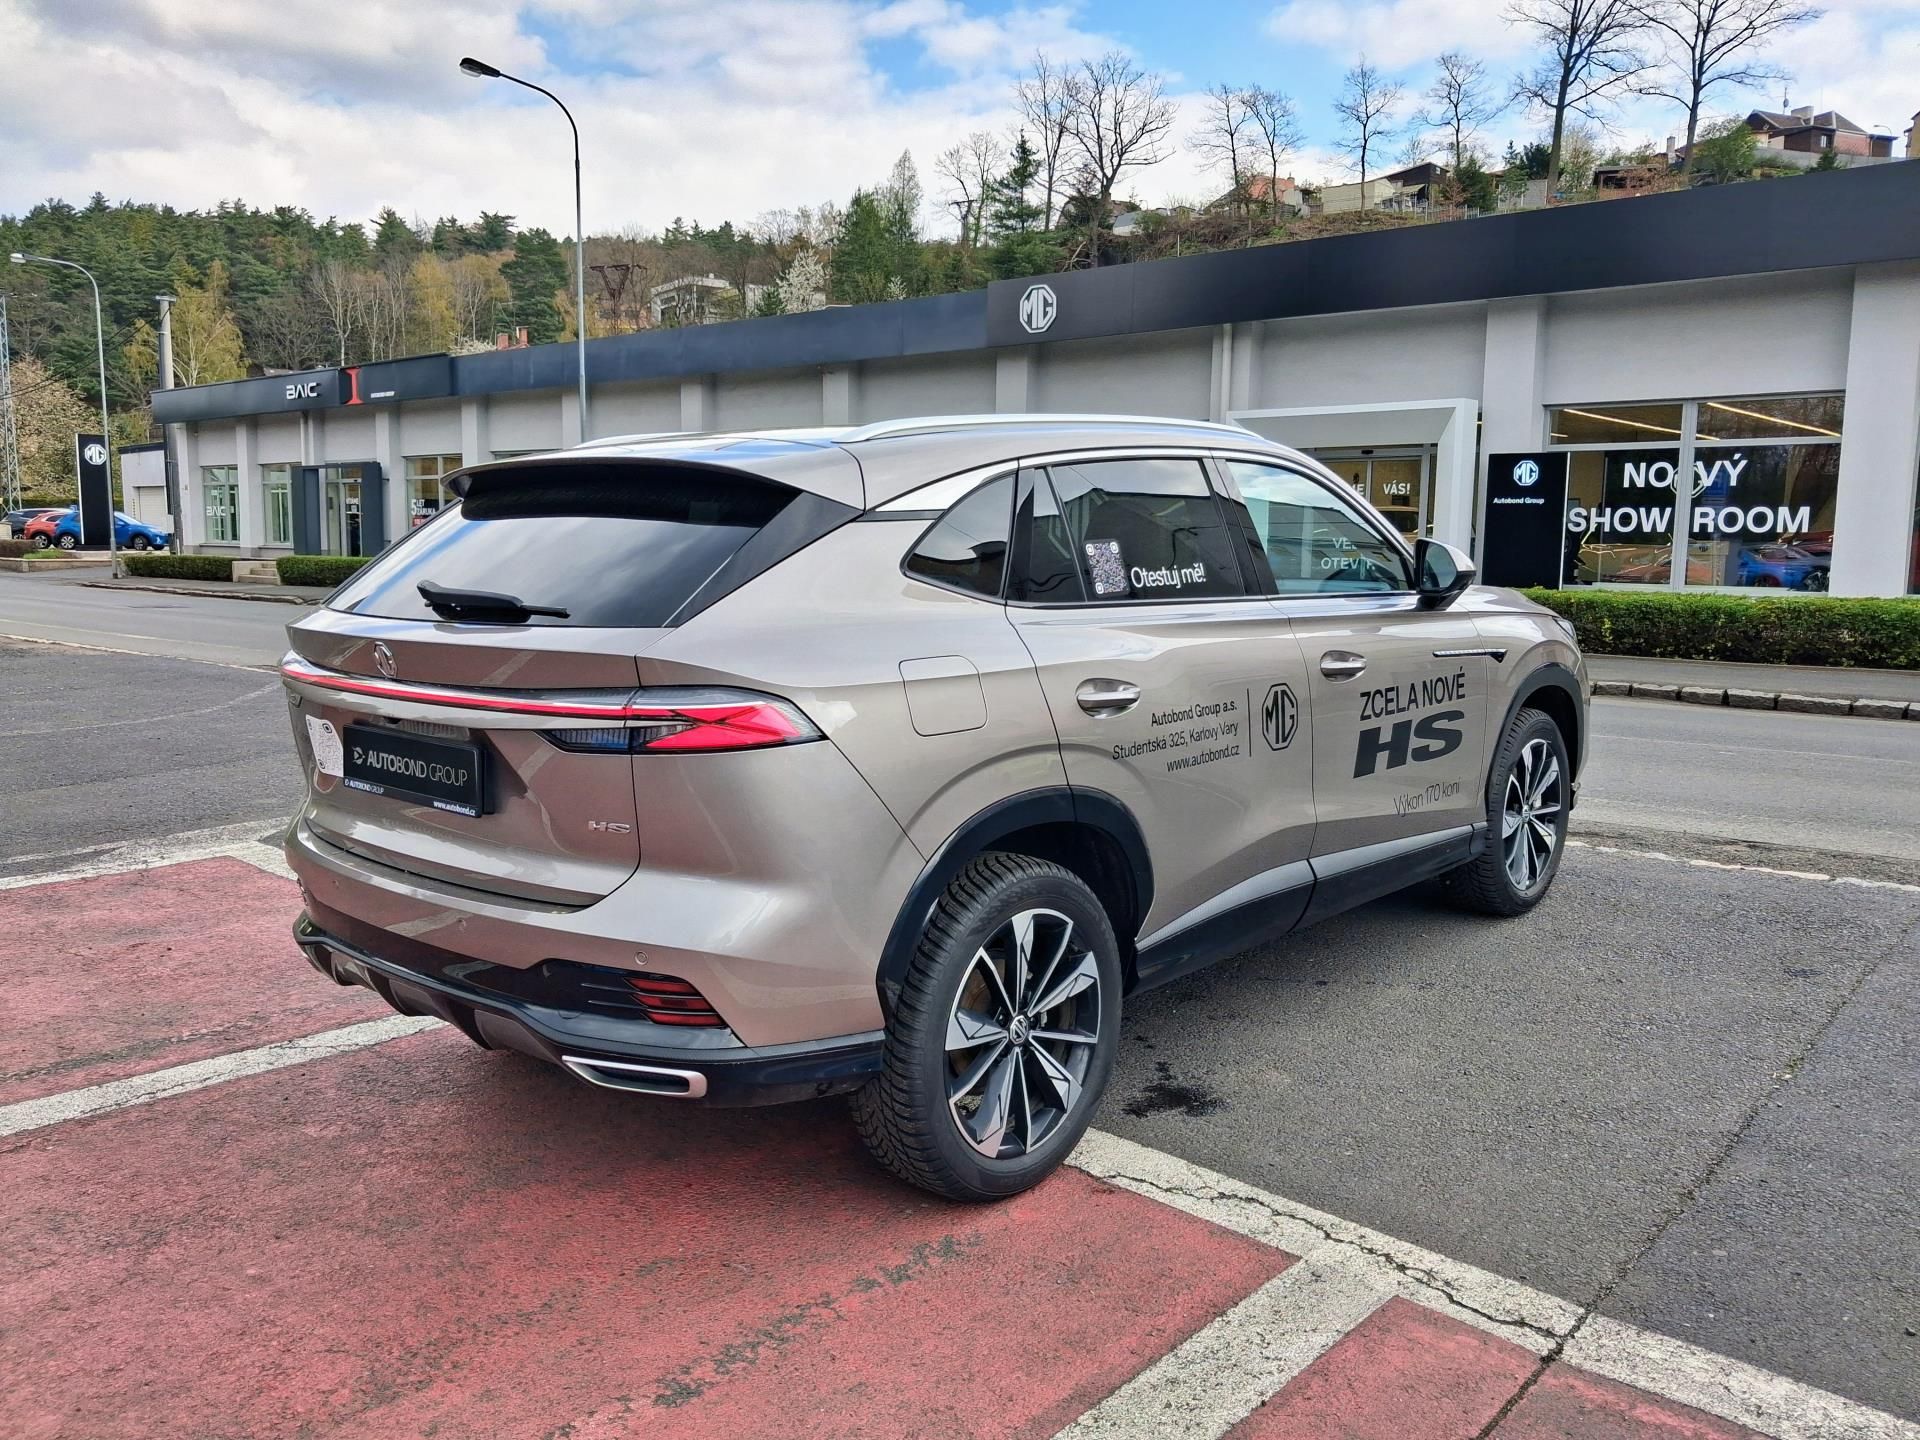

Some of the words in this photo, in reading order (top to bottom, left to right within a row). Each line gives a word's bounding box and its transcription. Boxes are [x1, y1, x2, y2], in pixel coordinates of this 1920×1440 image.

[1022, 287, 1054, 330] MG
[286, 382, 317, 400] BAIC
[86, 445, 105, 464] MG
[1515, 462, 1537, 484] MG
[1383, 480, 1411, 495] VÁS!
[1525, 497, 1545, 505] Group
[1130, 565, 1182, 589] Otestuj
[1182, 562, 1207, 583] mě!
[1360, 683, 1419, 721] ZCELA
[1422, 666, 1466, 708] NOVÉ
[1151, 706, 1194, 727] Autobond
[1195, 703, 1221, 718] Group
[1222, 700, 1237, 713] a.s.
[1264, 686, 1296, 747] MG
[1112, 734, 1167, 760] Studentská
[1169, 733, 1188, 748] 325,
[1189, 726, 1219, 743] Karlovy
[1219, 722, 1239, 737] Vary
[1353, 710, 1465, 779] HS
[366, 750, 427, 778] AUTOBOND
[428, 763, 468, 787] GROUP
[1166, 744, 1240, 772] www.autobond.cz
[433, 800, 476, 817] www.autobond.cz
[1393, 793, 1424, 818] Výkon
[1425, 783, 1440, 804] 170
[1443, 777, 1462, 797] koní
[588, 820, 630, 833] HS
